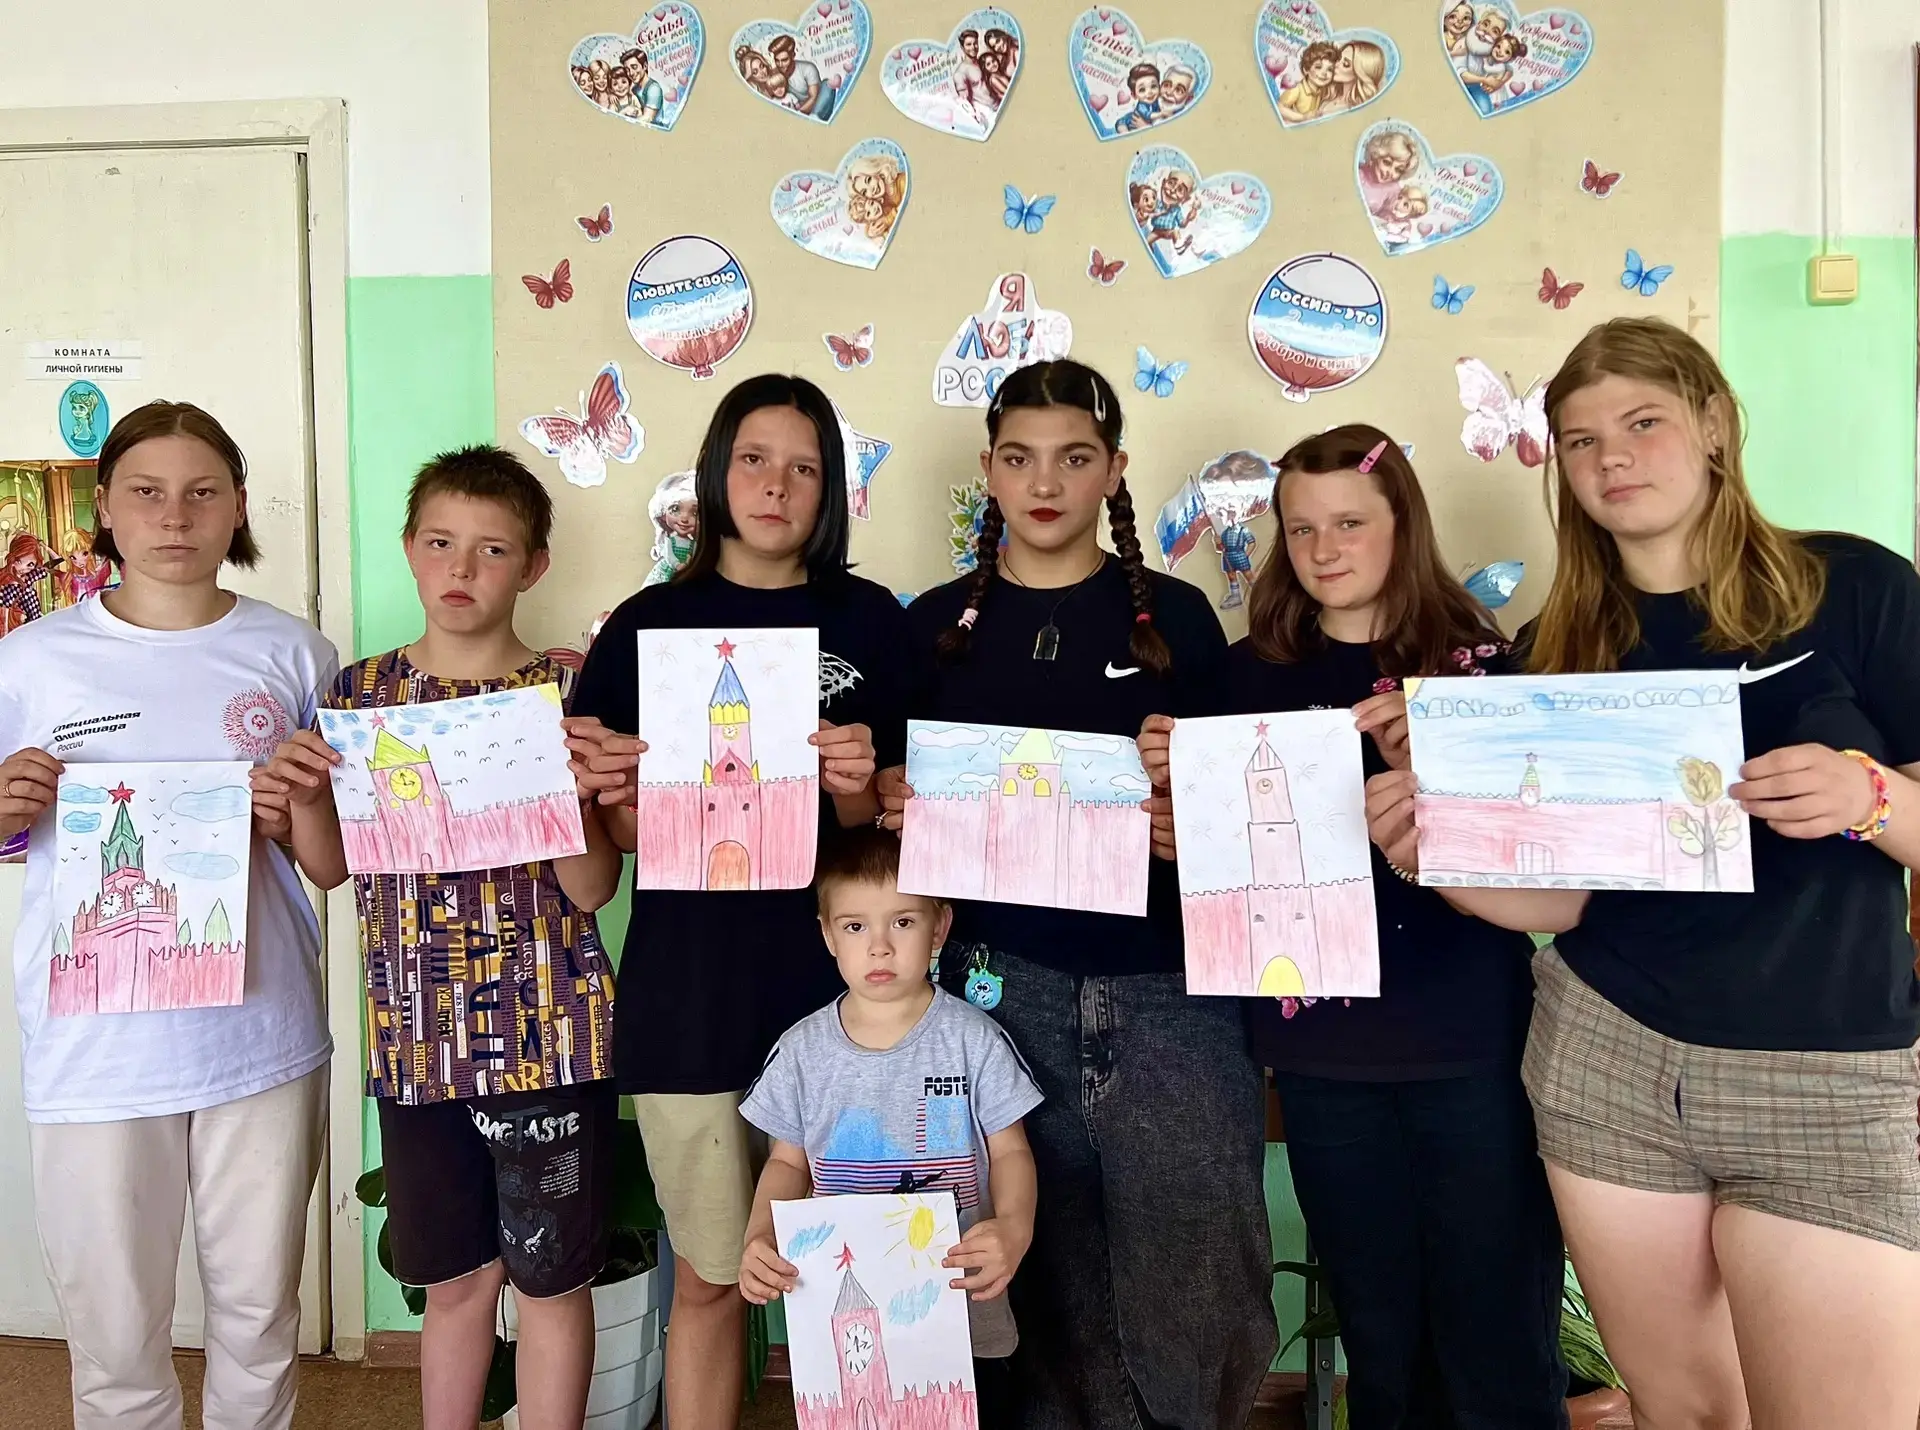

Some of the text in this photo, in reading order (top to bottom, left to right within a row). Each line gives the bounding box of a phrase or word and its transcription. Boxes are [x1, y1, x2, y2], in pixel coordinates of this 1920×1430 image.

[637, 16, 684, 45] Семья
[1083, 25, 1133, 57] Семья
[632, 280, 693, 302] ЛЮБИТЕ
[694, 270, 738, 290] СВОЮ
[1000, 273, 1025, 313] Я
[1269, 287, 1333, 315] РОССИЯ
[1343, 307, 1379, 328] ЭТО
[54, 348, 111, 357] КОМНАТА
[45, 363, 123, 374] ЛИЧНОЙ ГИГИЕНЫ
[52, 711, 141, 734] Специальная
[54, 723, 127, 742] Олимпиада
[57, 740, 84, 753] России
